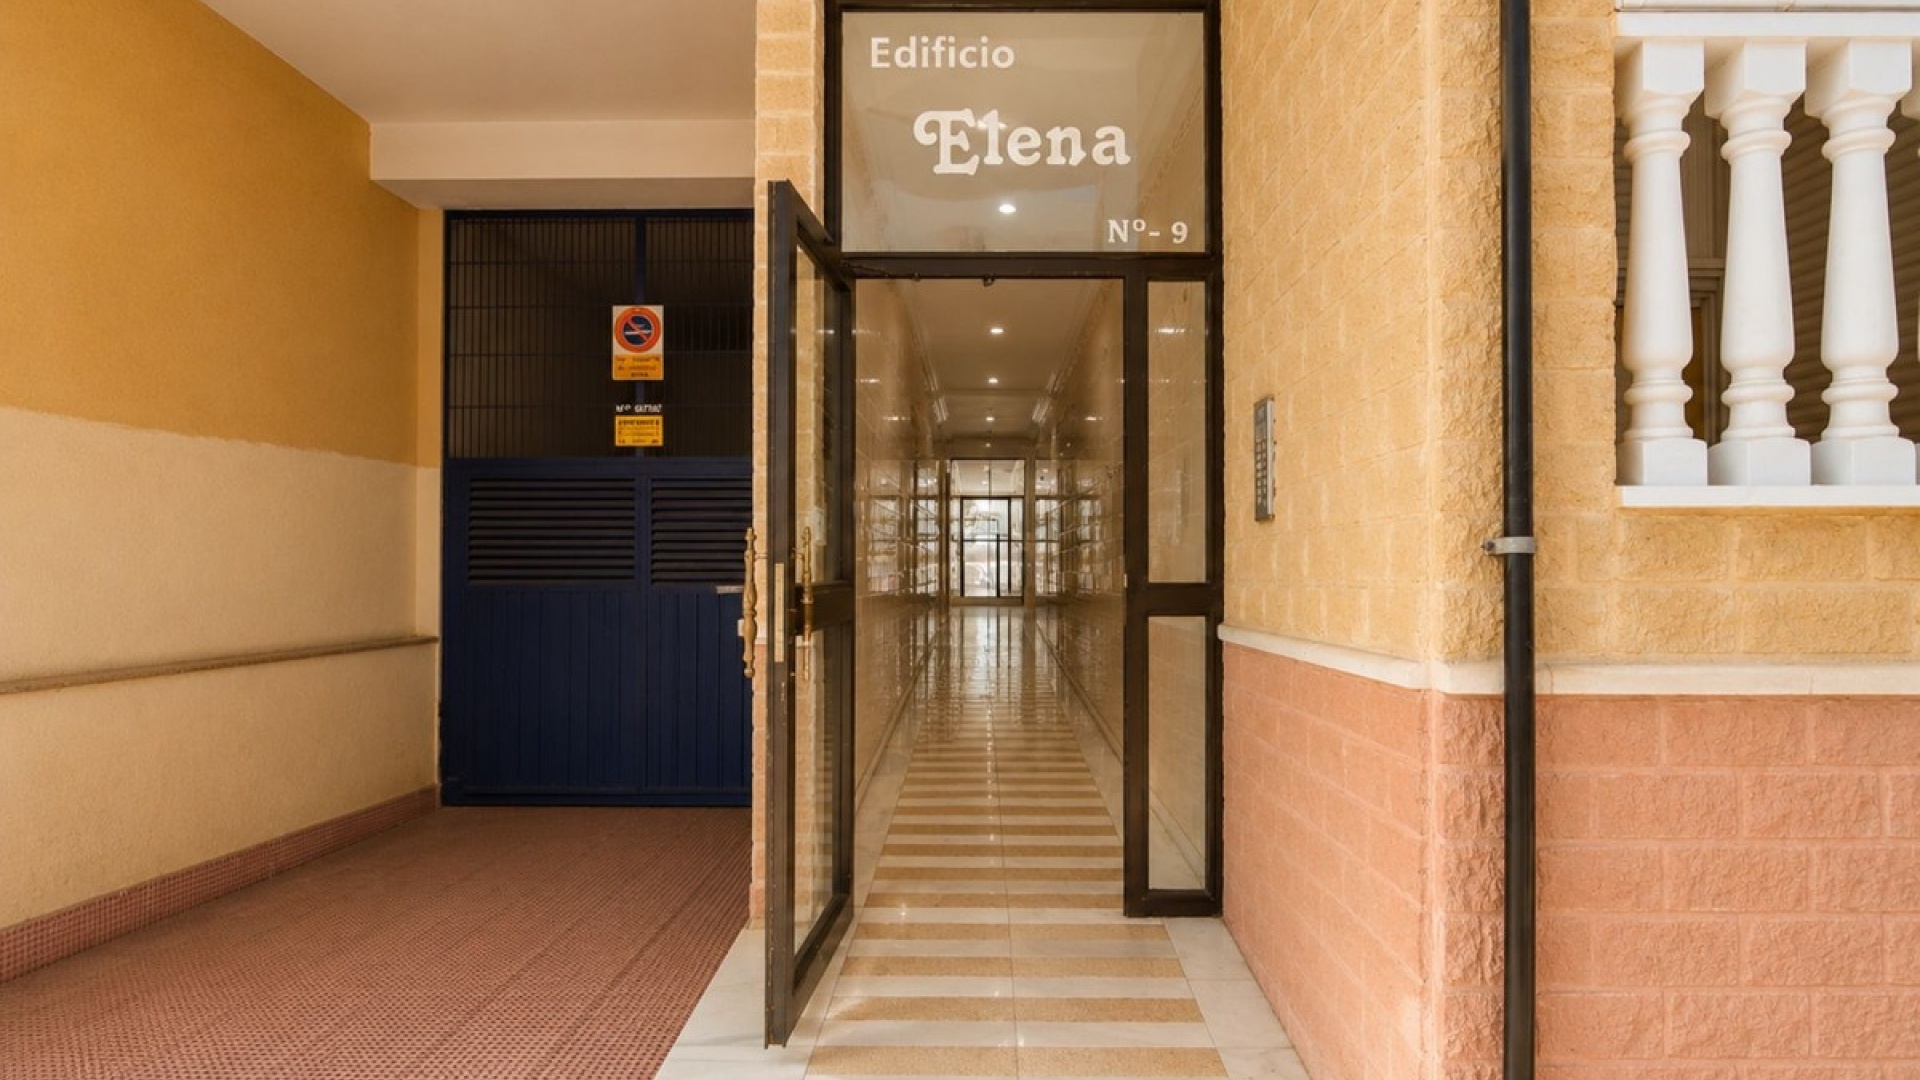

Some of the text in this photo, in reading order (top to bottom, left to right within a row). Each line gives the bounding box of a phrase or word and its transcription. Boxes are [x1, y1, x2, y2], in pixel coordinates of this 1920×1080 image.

[870, 36, 1015, 69] Edificio
[913, 107, 1131, 176] Elena
[1171, 222, 1188, 244] 9
